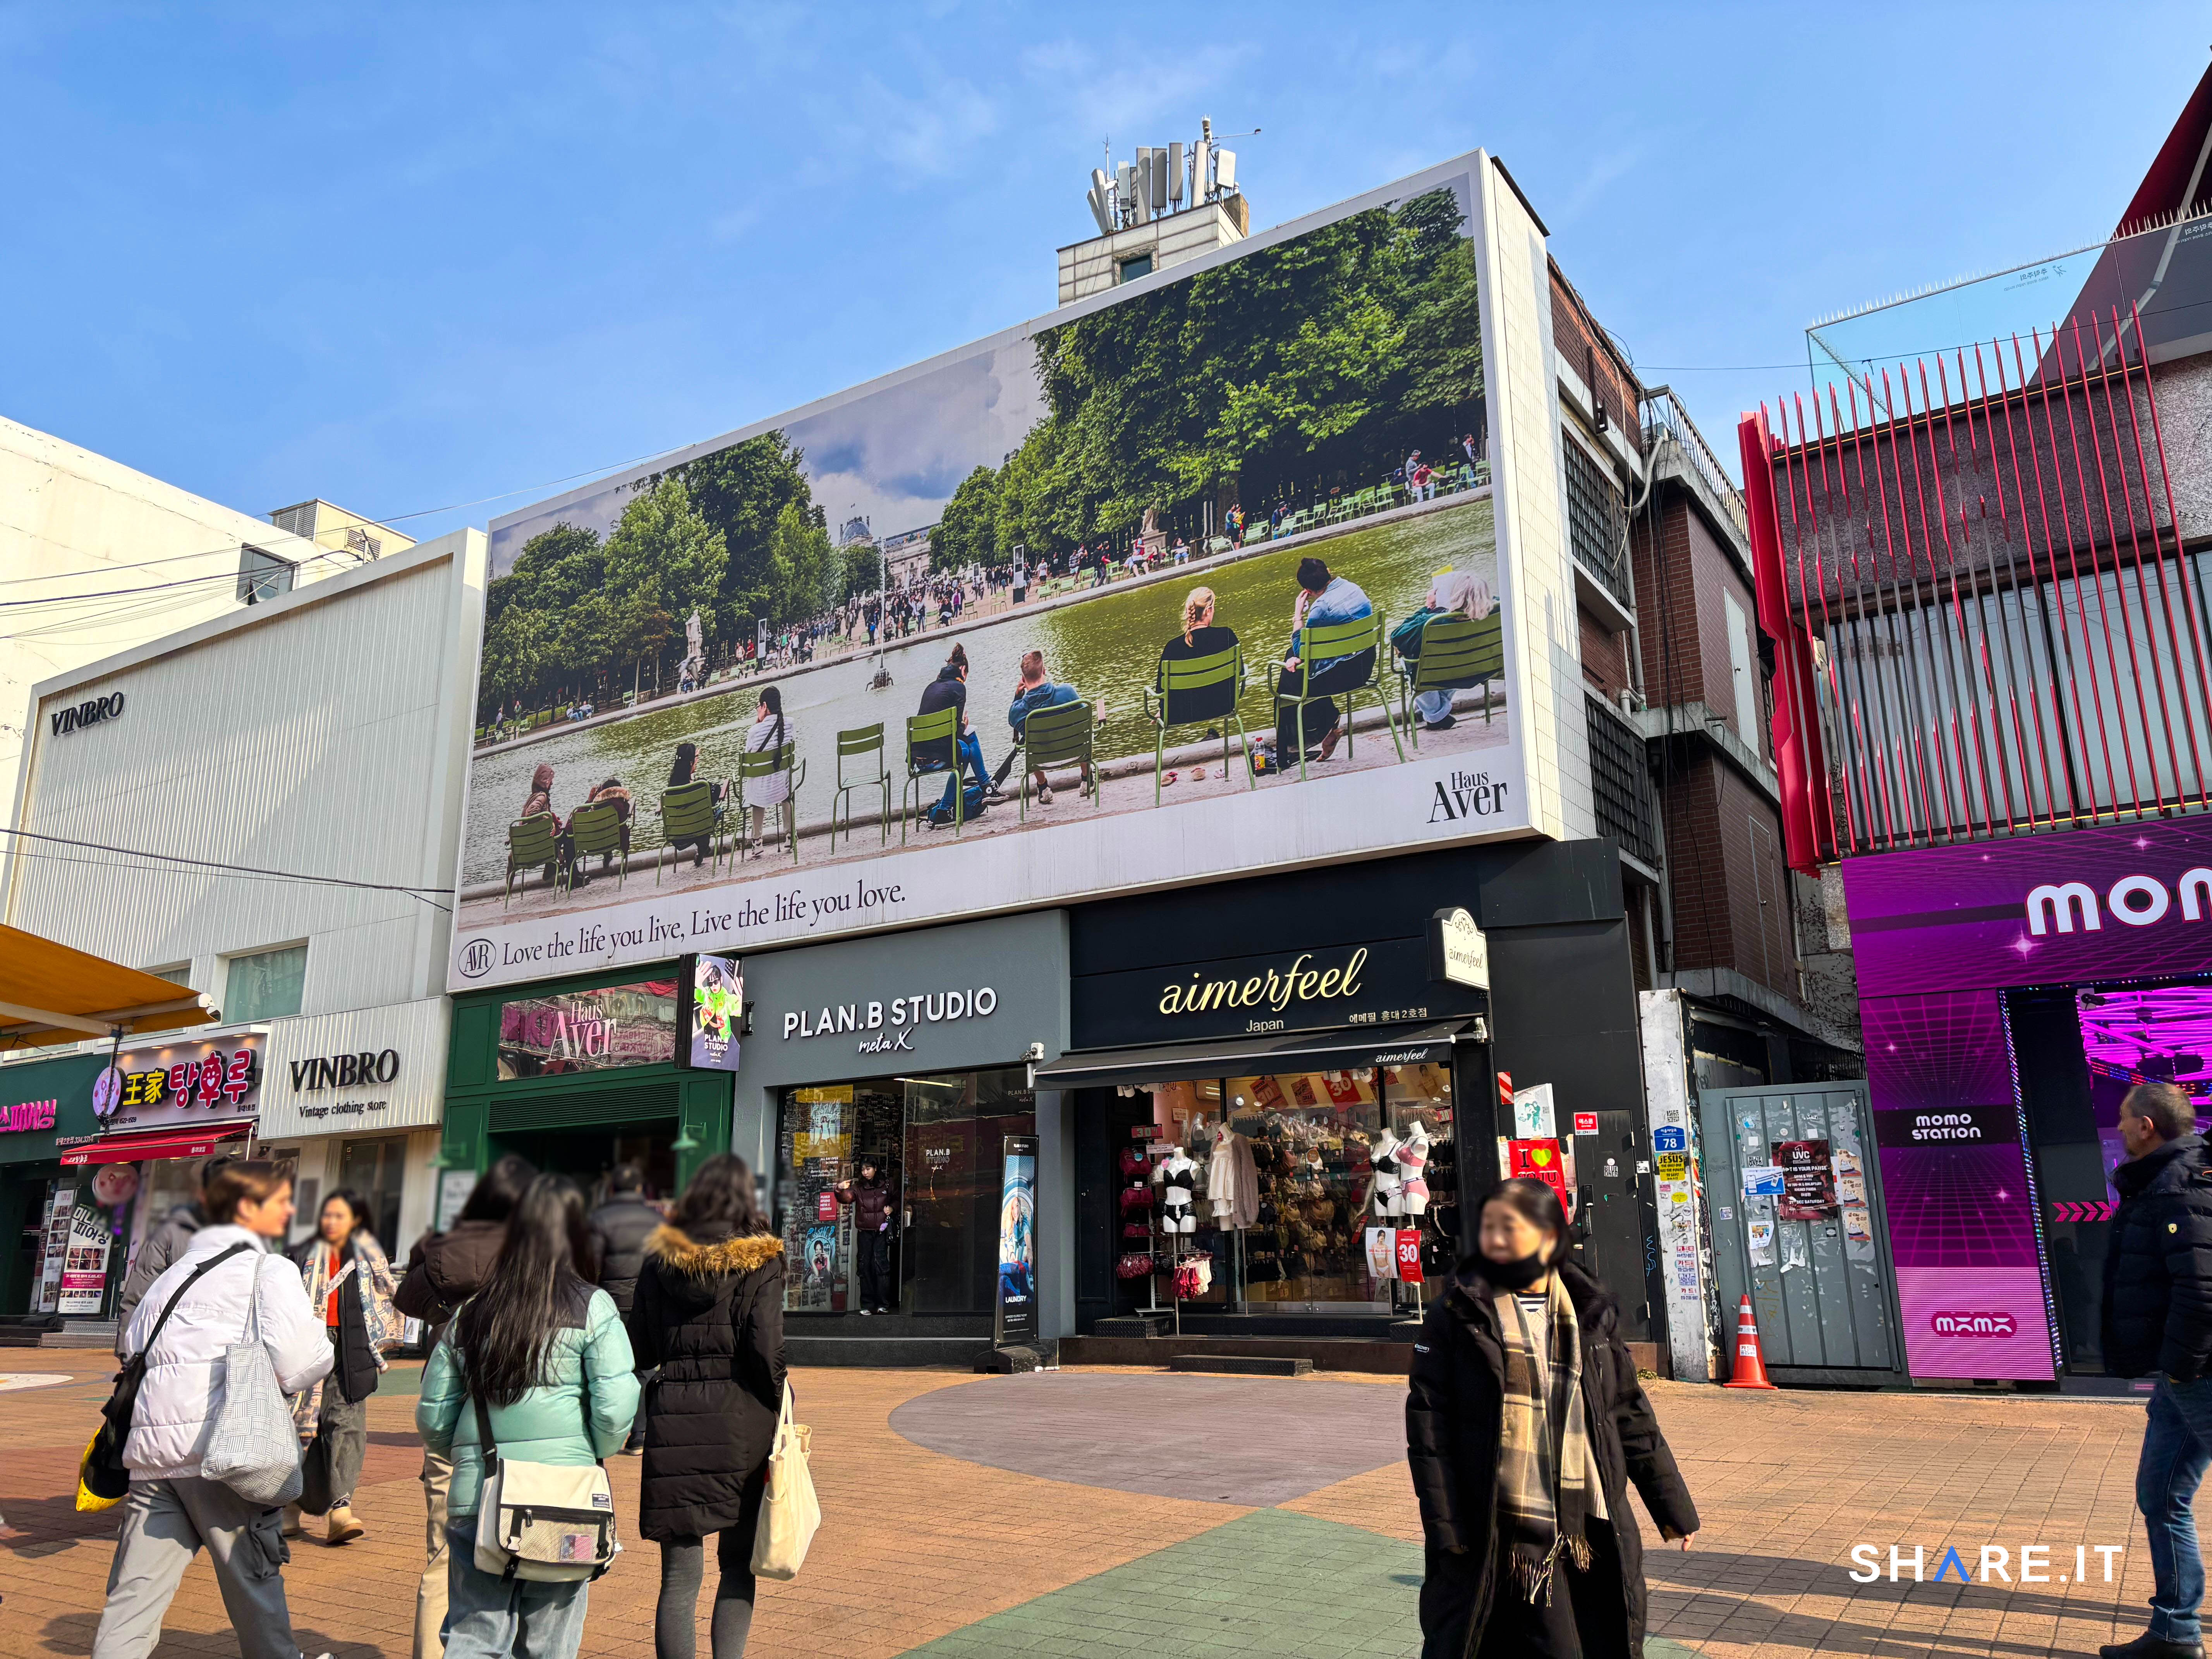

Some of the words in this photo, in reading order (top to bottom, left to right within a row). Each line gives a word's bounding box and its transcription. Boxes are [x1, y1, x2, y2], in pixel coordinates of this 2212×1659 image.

[51, 692, 124, 736] VINBRO
[1450, 771, 1489, 790] Haus
[1426, 781, 1508, 824] Aver
[503, 943, 542, 965] Love
[547, 931, 574, 958] the
[579, 924, 606, 954] life
[607, 928, 644, 959] you
[648, 915, 685, 943] live,
[690, 910, 732, 935] Live
[738, 898, 769, 928] the
[774, 890, 806, 922] life
[809, 893, 852, 927] you
[857, 879, 905, 908] love.
[463, 944, 489, 972] AVR
[1449, 946, 1483, 969] aimerfeel
[1159, 947, 1368, 1014] aimerfeel
[571, 1001, 603, 1024] Haus
[784, 1001, 883, 1039] PLAN.B
[891, 987, 998, 1025] STUDIO
[1349, 1012, 1377, 1024] 에메필
[1381, 1010, 1400, 1021] 홍대
[1401, 1007, 1427, 1018] 2호점
[545, 1010, 617, 1061] Aver
[1245, 1018, 1284, 1033] Japan
[704, 1042, 728, 1051] STUDIO
[859, 1032, 893, 1054] meta
[893, 1027, 915, 1051] X
[1376, 1048, 1429, 1063] aimerfeel
[168, 1048, 251, 1109] 탕후루
[289, 1049, 400, 1092] VINBRO
[122, 1069, 165, 1106] 王家
[1330, 1077, 1352, 1097] 30
[299, 1106, 329, 1119] Vintage
[331, 1100, 364, 1115] clothing
[367, 1100, 386, 1111] store
[926, 1148, 950, 1156] PLAN.B
[1662, 1138, 1677, 1149] 78
[1518, 1148, 1530, 1168] I
[1659, 1155, 1683, 1163] JESUS
[1792, 1151, 1810, 1159] UVC
[73, 1221, 109, 1245] 피어싱
[1399, 1243, 1418, 1262] 30
[1005, 1295, 1027, 1303] LAUNDRY
